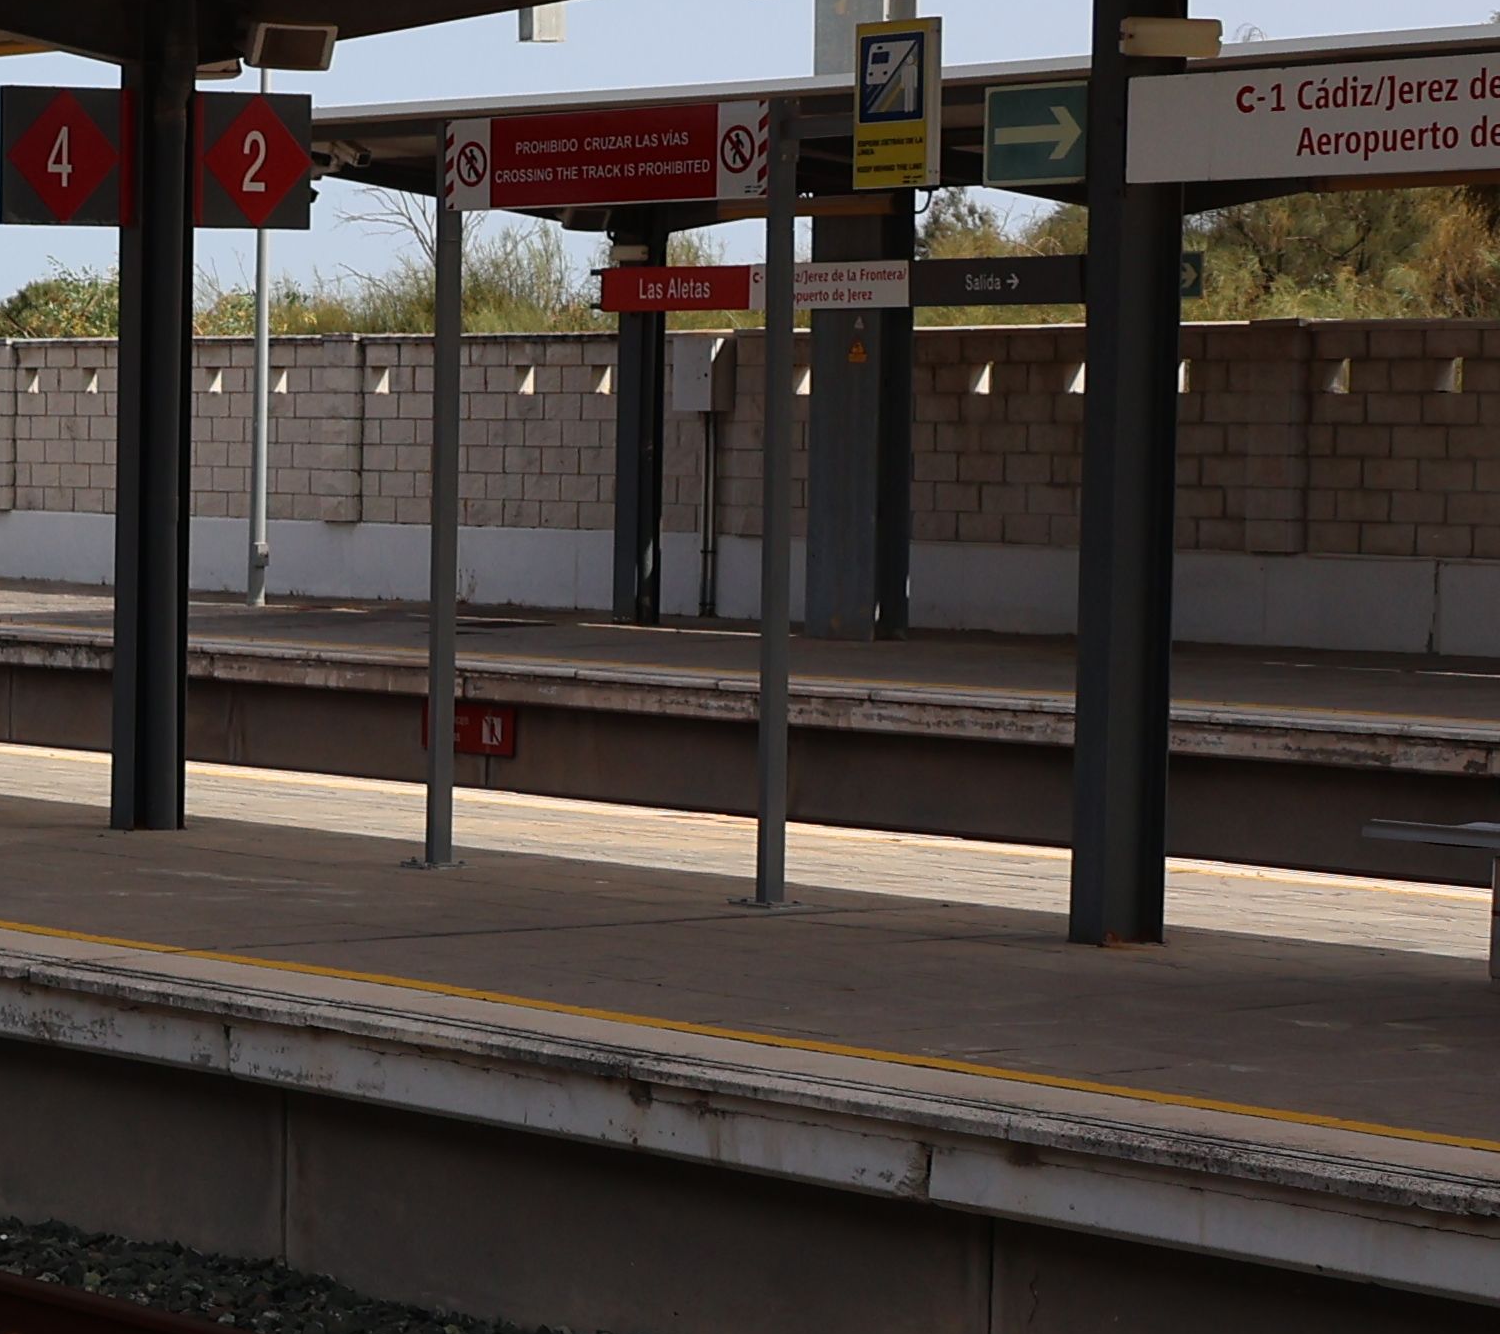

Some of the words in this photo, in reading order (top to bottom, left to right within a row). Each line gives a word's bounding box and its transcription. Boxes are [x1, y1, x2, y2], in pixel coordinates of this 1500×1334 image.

[1236, 83, 1286, 113] C-1
[1297, 75, 1459, 111] Cádiz/Jerez
[515, 139, 578, 155] PROHIBIDO
[584, 136, 632, 151] CRUZAR
[635, 134, 659, 148] LAS
[1296, 121, 1459, 161] Aeropuerto
[46, 125, 73, 188] 4
[241, 129, 266, 192] 2
[495, 168, 553, 183] CROSSING
[556, 166, 578, 180] THE
[582, 164, 621, 178] TRACK
[624, 162, 635, 176] IS
[639, 159, 710, 176] PROHIBITED
[752, 272, 764, 283] C-
[794, 270, 829, 285] z/Jerez
[831, 270, 845, 282] de
[846, 269, 857, 281] la
[965, 273, 1001, 291] Salida
[639, 278, 663, 299] Las
[667, 278, 711, 299] Aletas
[832, 288, 845, 301] de
[847, 288, 873, 303] Jerez
